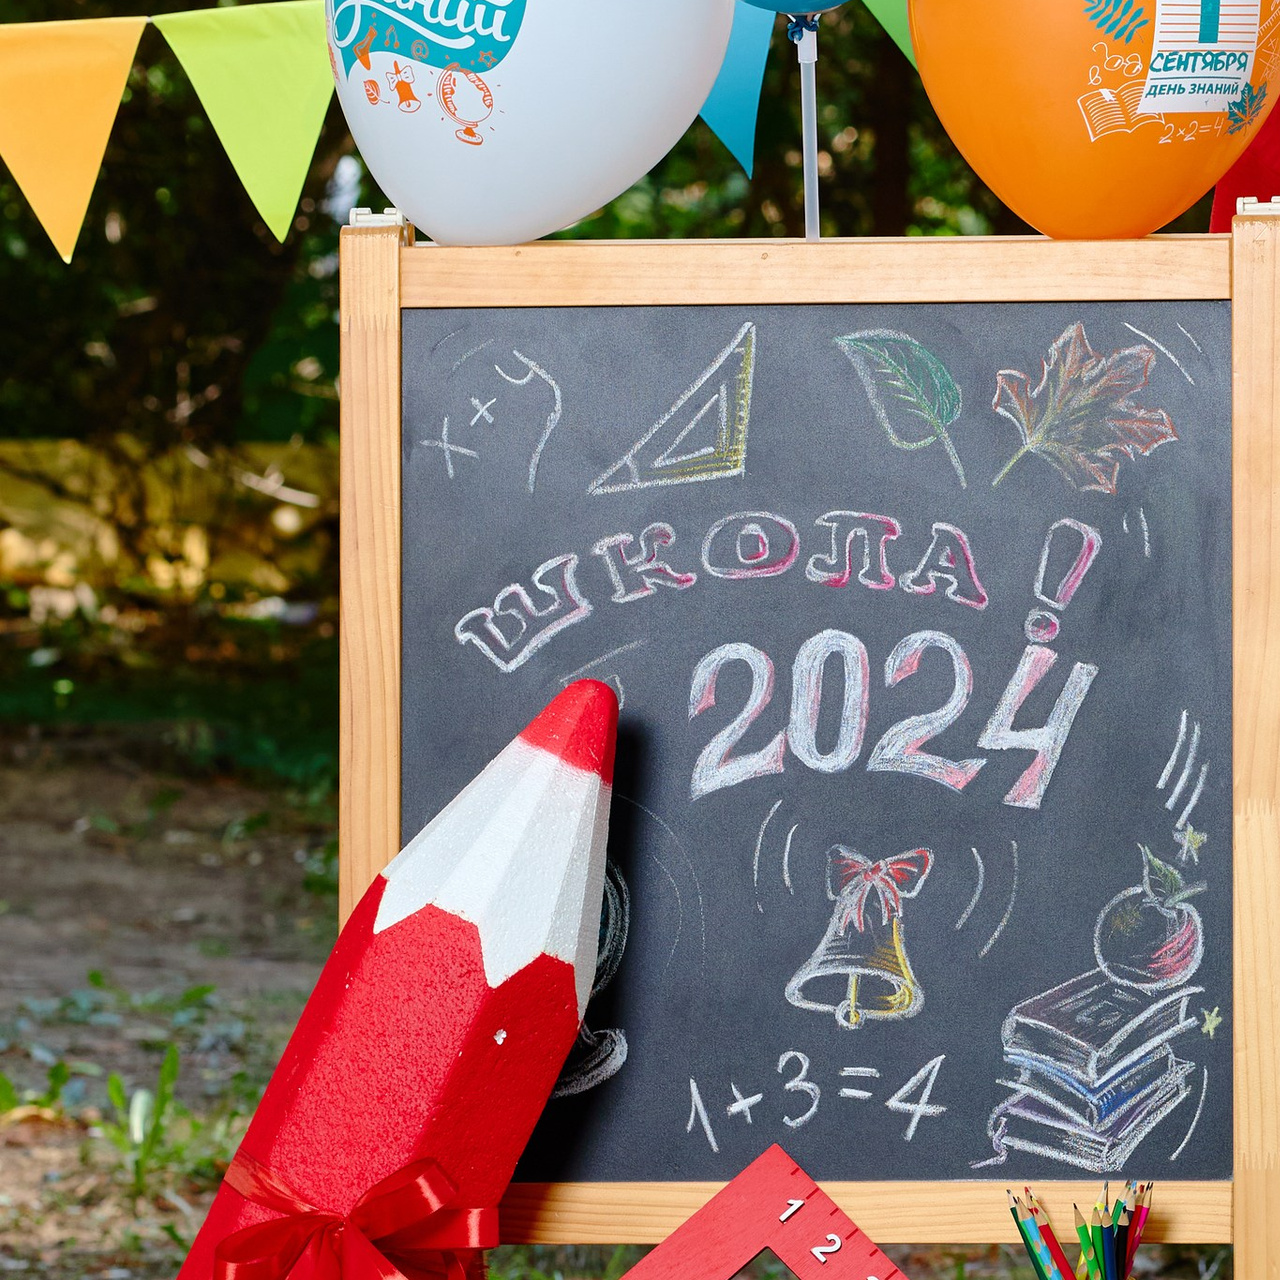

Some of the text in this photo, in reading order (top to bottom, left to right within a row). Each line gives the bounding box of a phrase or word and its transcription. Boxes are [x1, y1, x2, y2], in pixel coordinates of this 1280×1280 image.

[1149, 50, 1249, 74] СЕНТЯБРЯ
[1145, 82, 1240, 99] ДЕНЬ ЗНАНИЙ
[687, 627, 1100, 811] 2024
[777, 1197, 805, 1224] 1
[810, 1232, 843, 1265] 2
